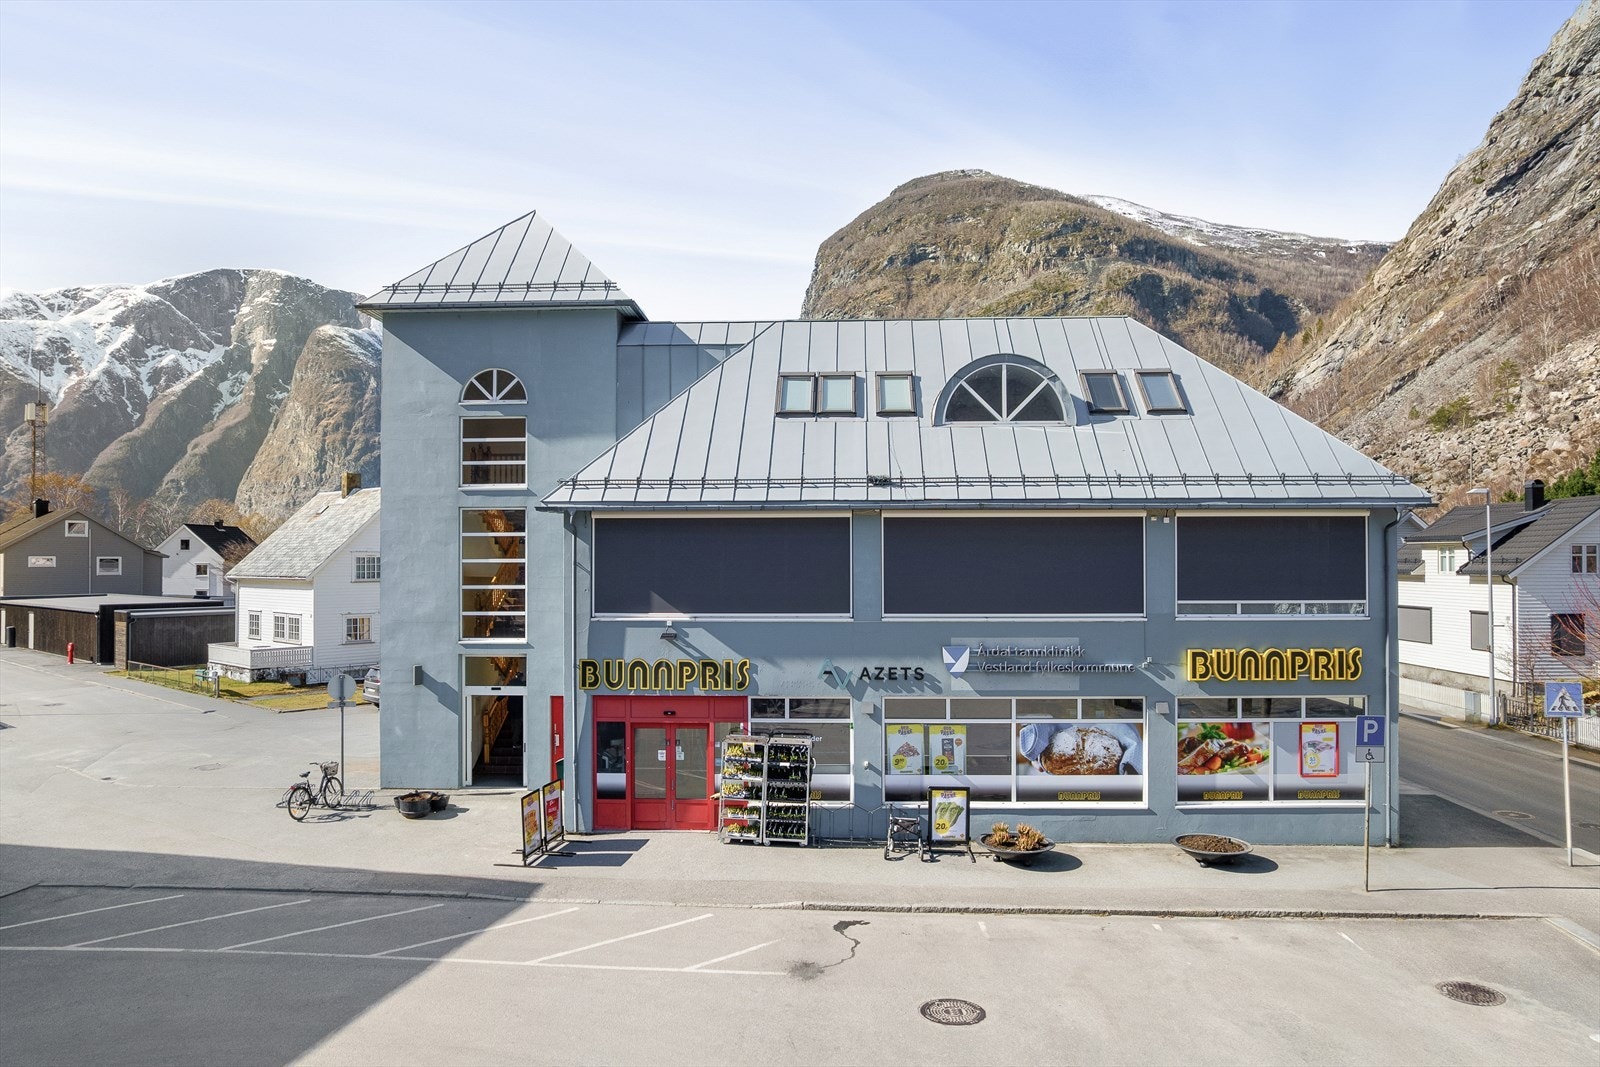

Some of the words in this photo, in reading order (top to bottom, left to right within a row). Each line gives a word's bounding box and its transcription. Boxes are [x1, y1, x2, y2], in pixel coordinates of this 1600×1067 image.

[976, 642, 1011, 657] Årdal
[1014, 644, 1085, 657] tannklinikk
[859, 666, 925, 681] AZETS
[976, 661, 1032, 673] Vestland
[1034, 661, 1136, 675] fylkeskommune
[1187, 647, 1363, 681] BUNNPRIS
[578, 658, 750, 691] BUNNPRIS
[1363, 719, 1379, 743] P
